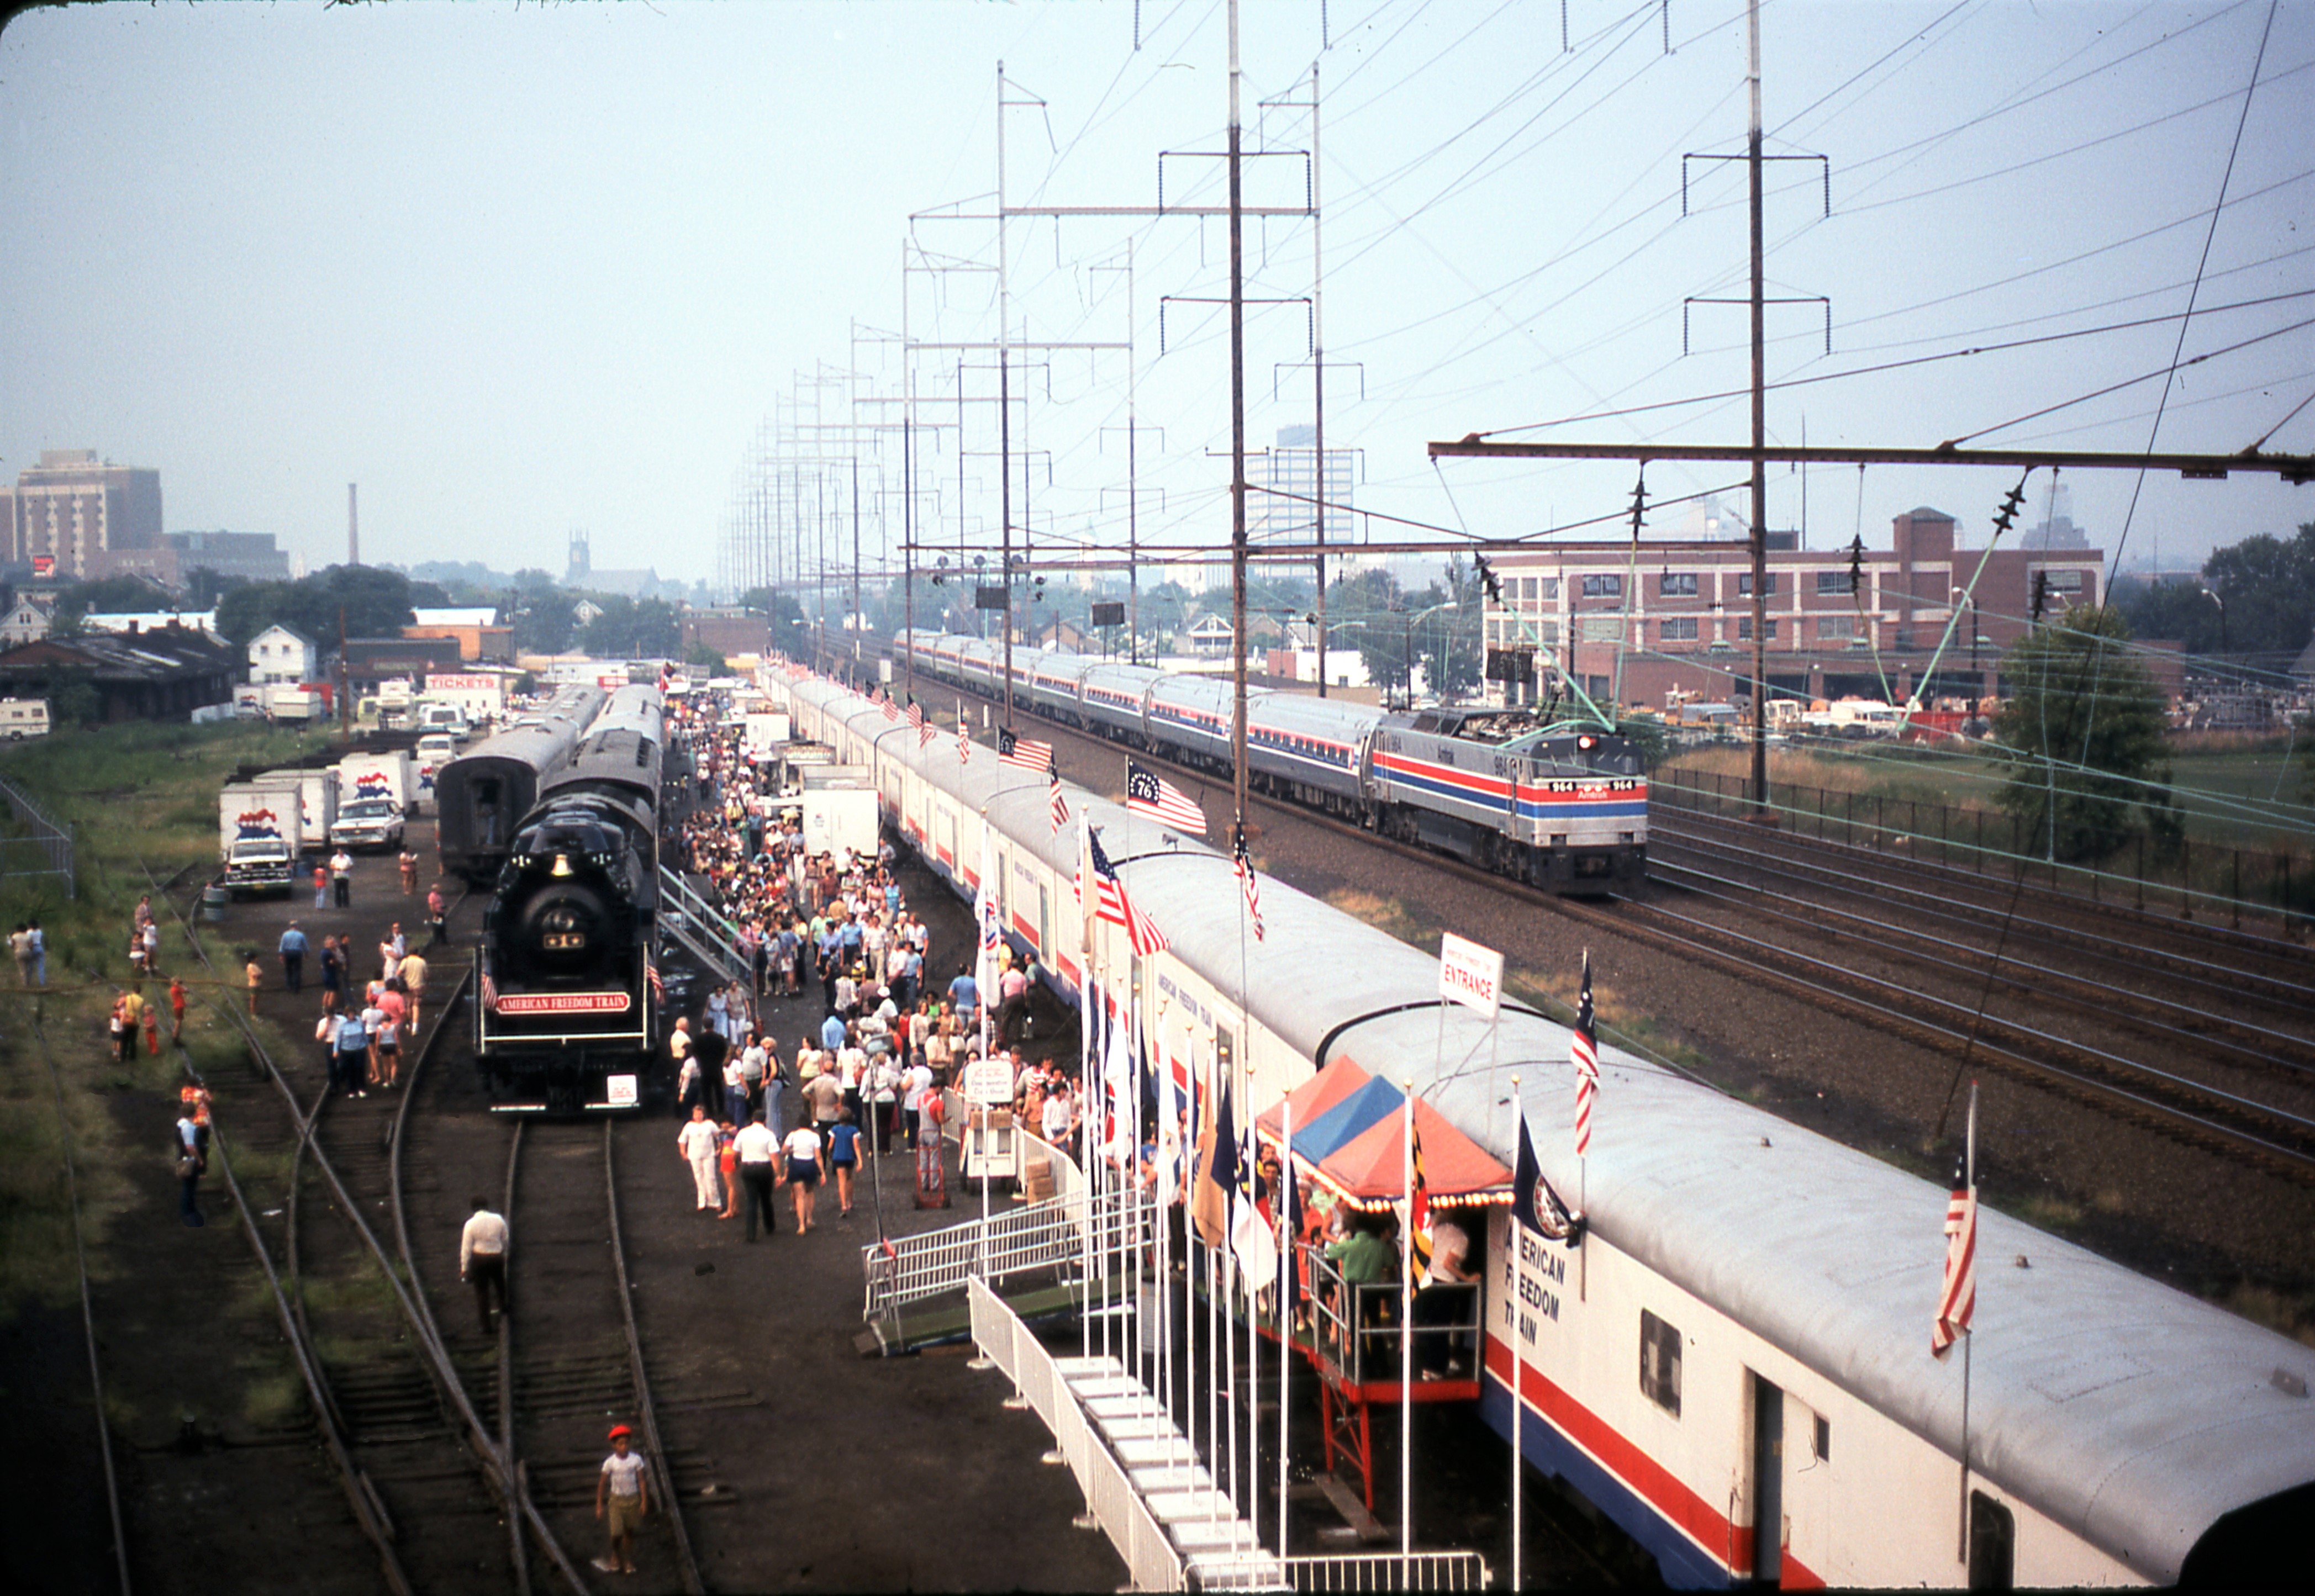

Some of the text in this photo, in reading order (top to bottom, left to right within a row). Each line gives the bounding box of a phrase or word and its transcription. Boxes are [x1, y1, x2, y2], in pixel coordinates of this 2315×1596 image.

[430, 679, 494, 688] TICKETS
[1138, 780, 1152, 798] 76
[1553, 782, 1573, 792] 964
[1613, 780, 1633, 790] 964
[1578, 790, 1608, 799] Amtrak
[559, 933, 568, 948] 1
[1444, 963, 1493, 1001] ENTRANCE
[502, 996, 625, 1010] AMERICAN FREEDOM TRAIN
[1505, 1224, 1565, 1286] AERICAN
[1505, 1262, 1559, 1323] FEEDOM
